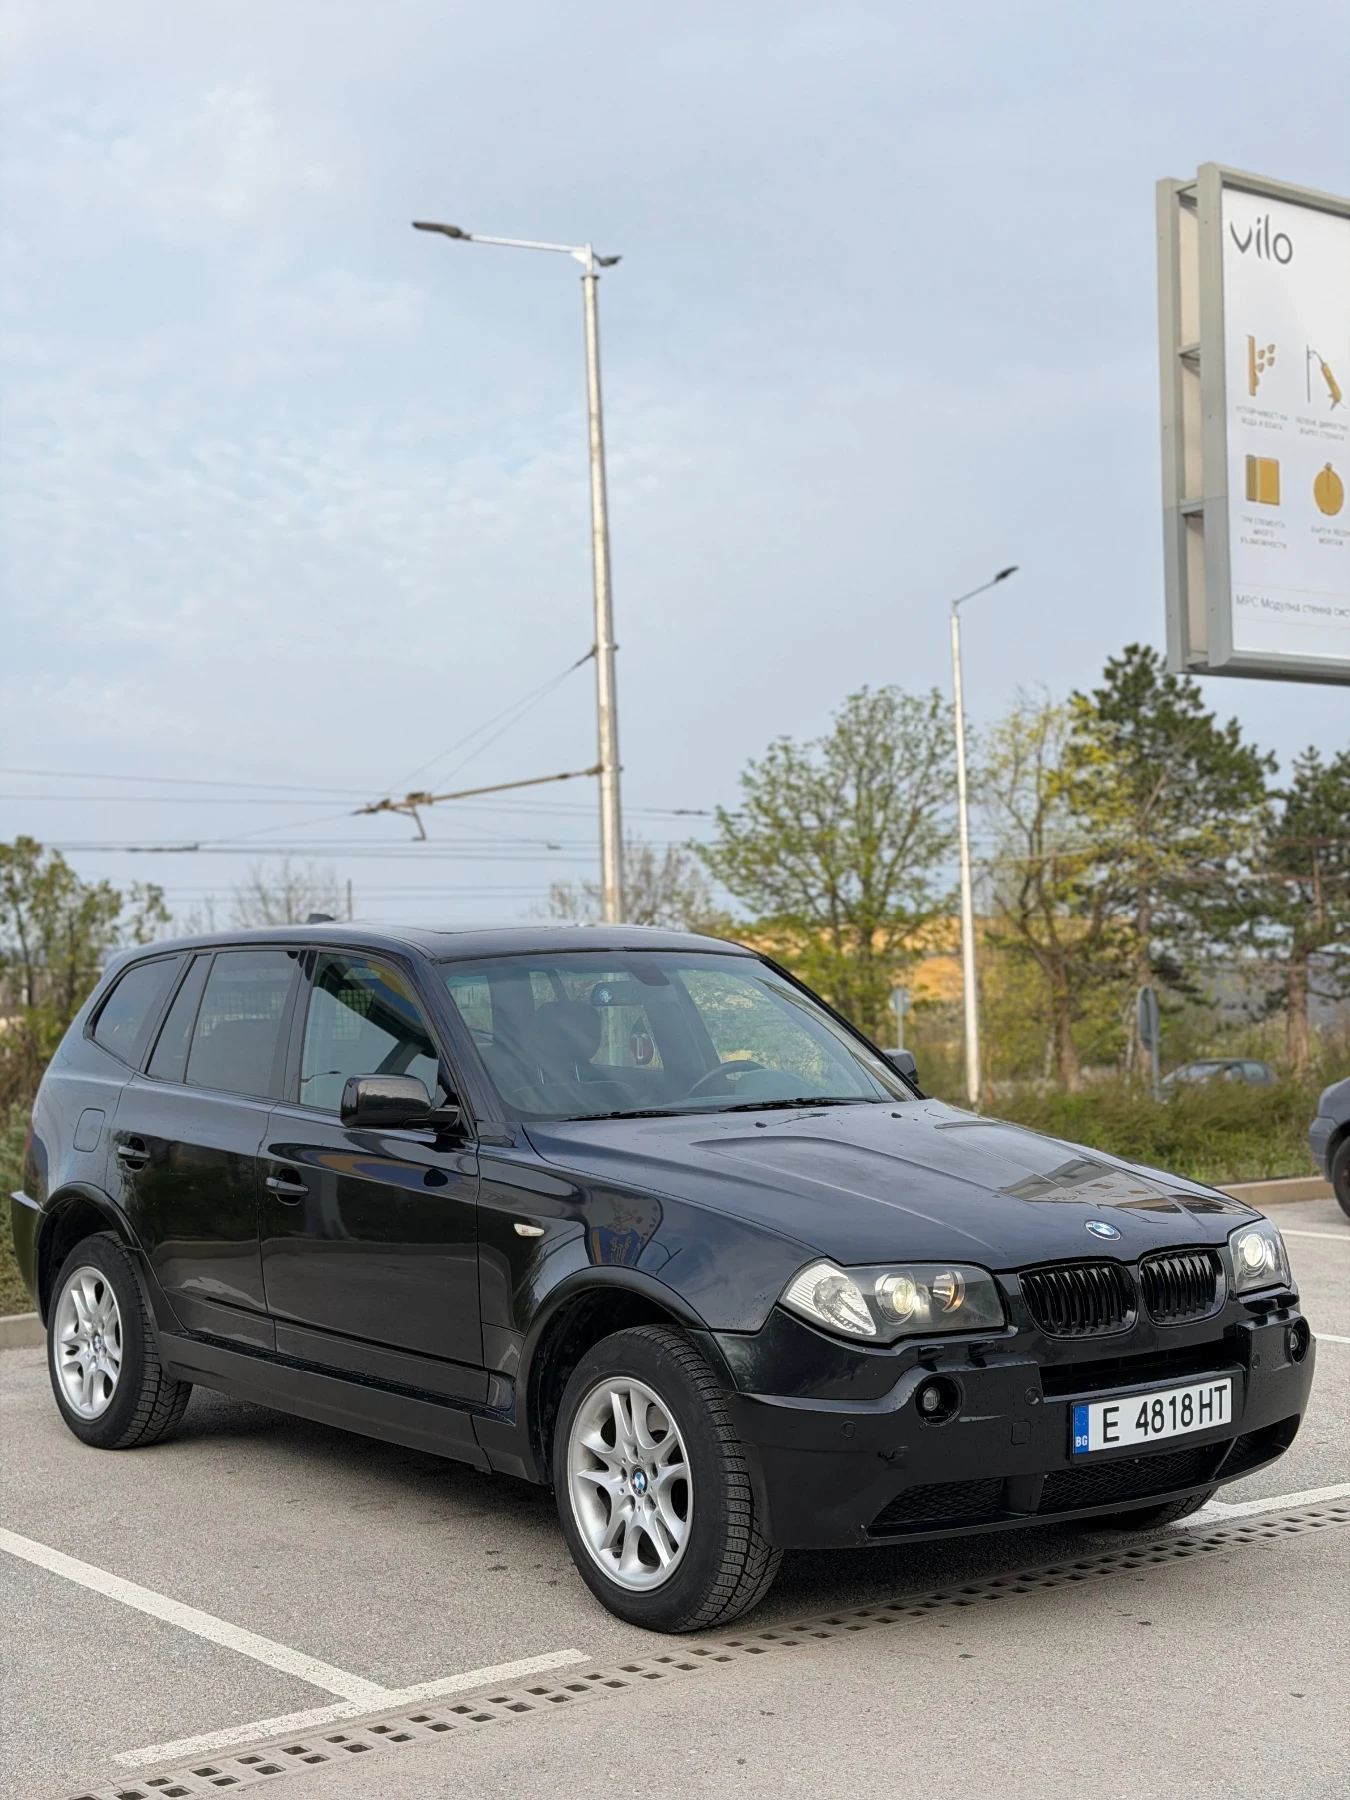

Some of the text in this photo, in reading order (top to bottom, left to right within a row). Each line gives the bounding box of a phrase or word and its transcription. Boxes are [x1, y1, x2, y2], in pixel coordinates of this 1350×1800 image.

[1230, 213, 1293, 265] vilo
[1075, 1434, 1088, 1448] BG
[1103, 1406, 1120, 1444] E
